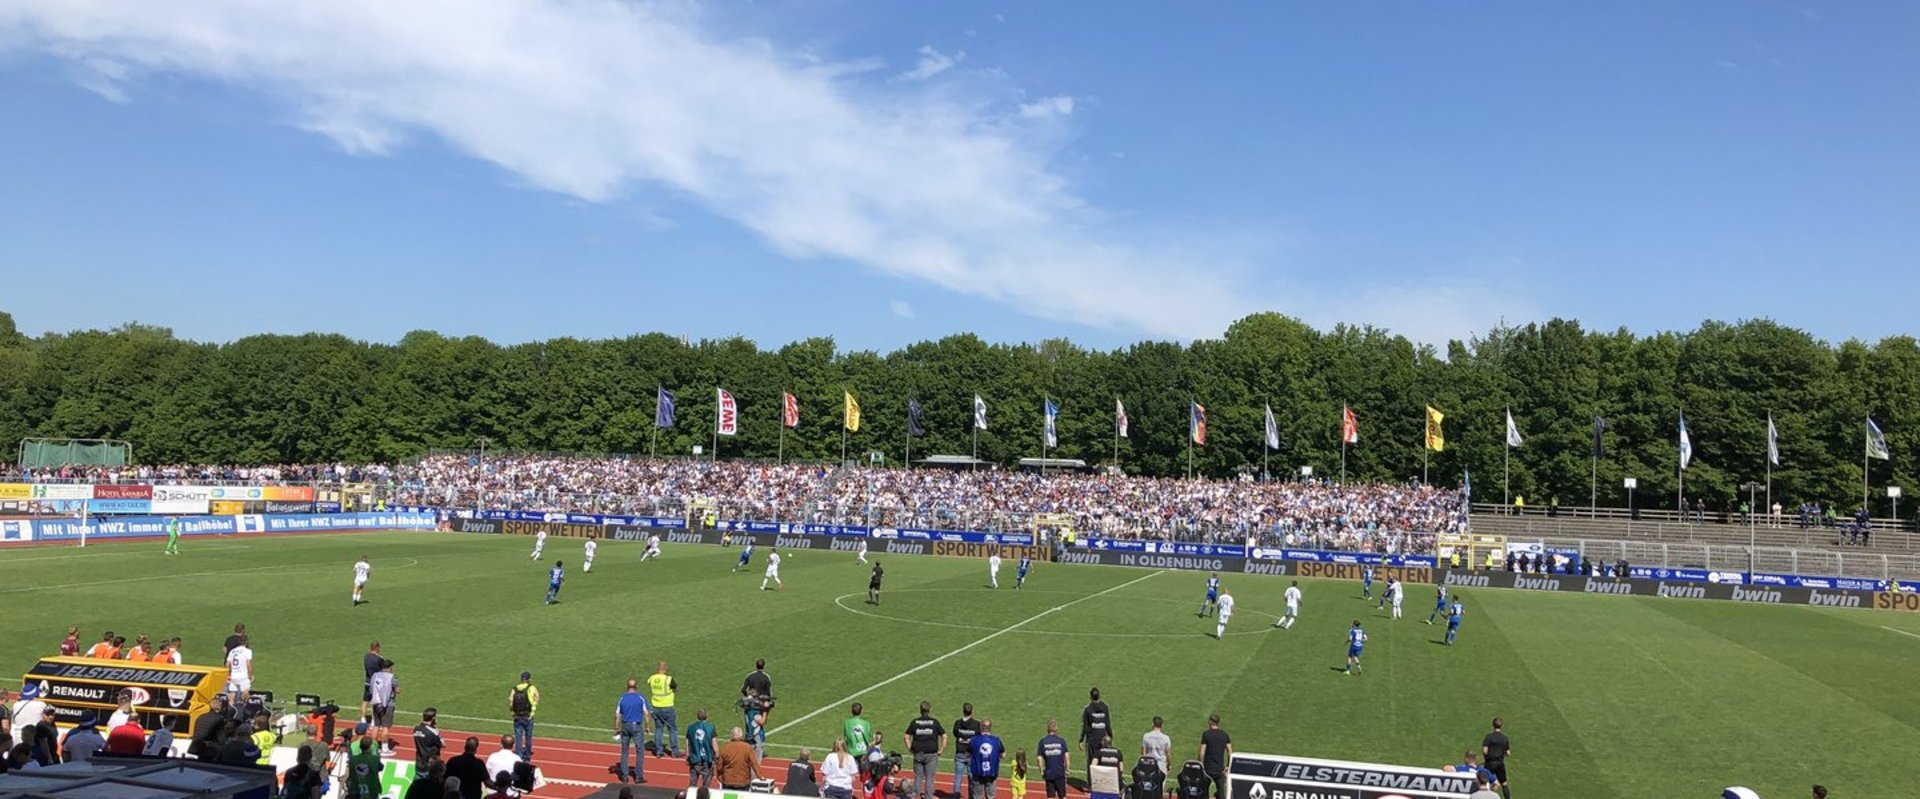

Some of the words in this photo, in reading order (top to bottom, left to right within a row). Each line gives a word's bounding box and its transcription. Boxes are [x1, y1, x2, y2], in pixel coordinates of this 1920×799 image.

[42, 523, 64, 535] Mit
[99, 522, 126, 533] NWZ
[310, 517, 331, 526] NWZ
[358, 516, 376, 526] auf
[462, 519, 494, 533] bwin
[506, 520, 603, 538] SPORTWETTEN
[615, 526, 649, 541] bwin
[667, 528, 703, 543] bwin
[775, 534, 811, 548] bwin
[886, 538, 924, 554] bwin
[936, 540, 1048, 561] SPORTWETTEN
[1062, 548, 1101, 564] bwin
[1119, 553, 1136, 565] IN
[1138, 554, 1223, 570] OLDENBURG
[1244, 558, 1287, 575] bwin
[1444, 570, 1490, 587] bwin
[1513, 573, 1560, 590] bwin
[1584, 577, 1632, 595] bwin
[1656, 580, 1706, 598] bwin
[1731, 584, 1783, 603] bwin
[1808, 588, 1861, 607] bwin
[1878, 593, 1919, 610] SPO
[232, 654, 240, 666] 6
[64, 665, 198, 684] ELSTERMANN
[52, 685, 105, 699] RENAULT
[1283, 764, 1473, 793] ELSTERMANN
